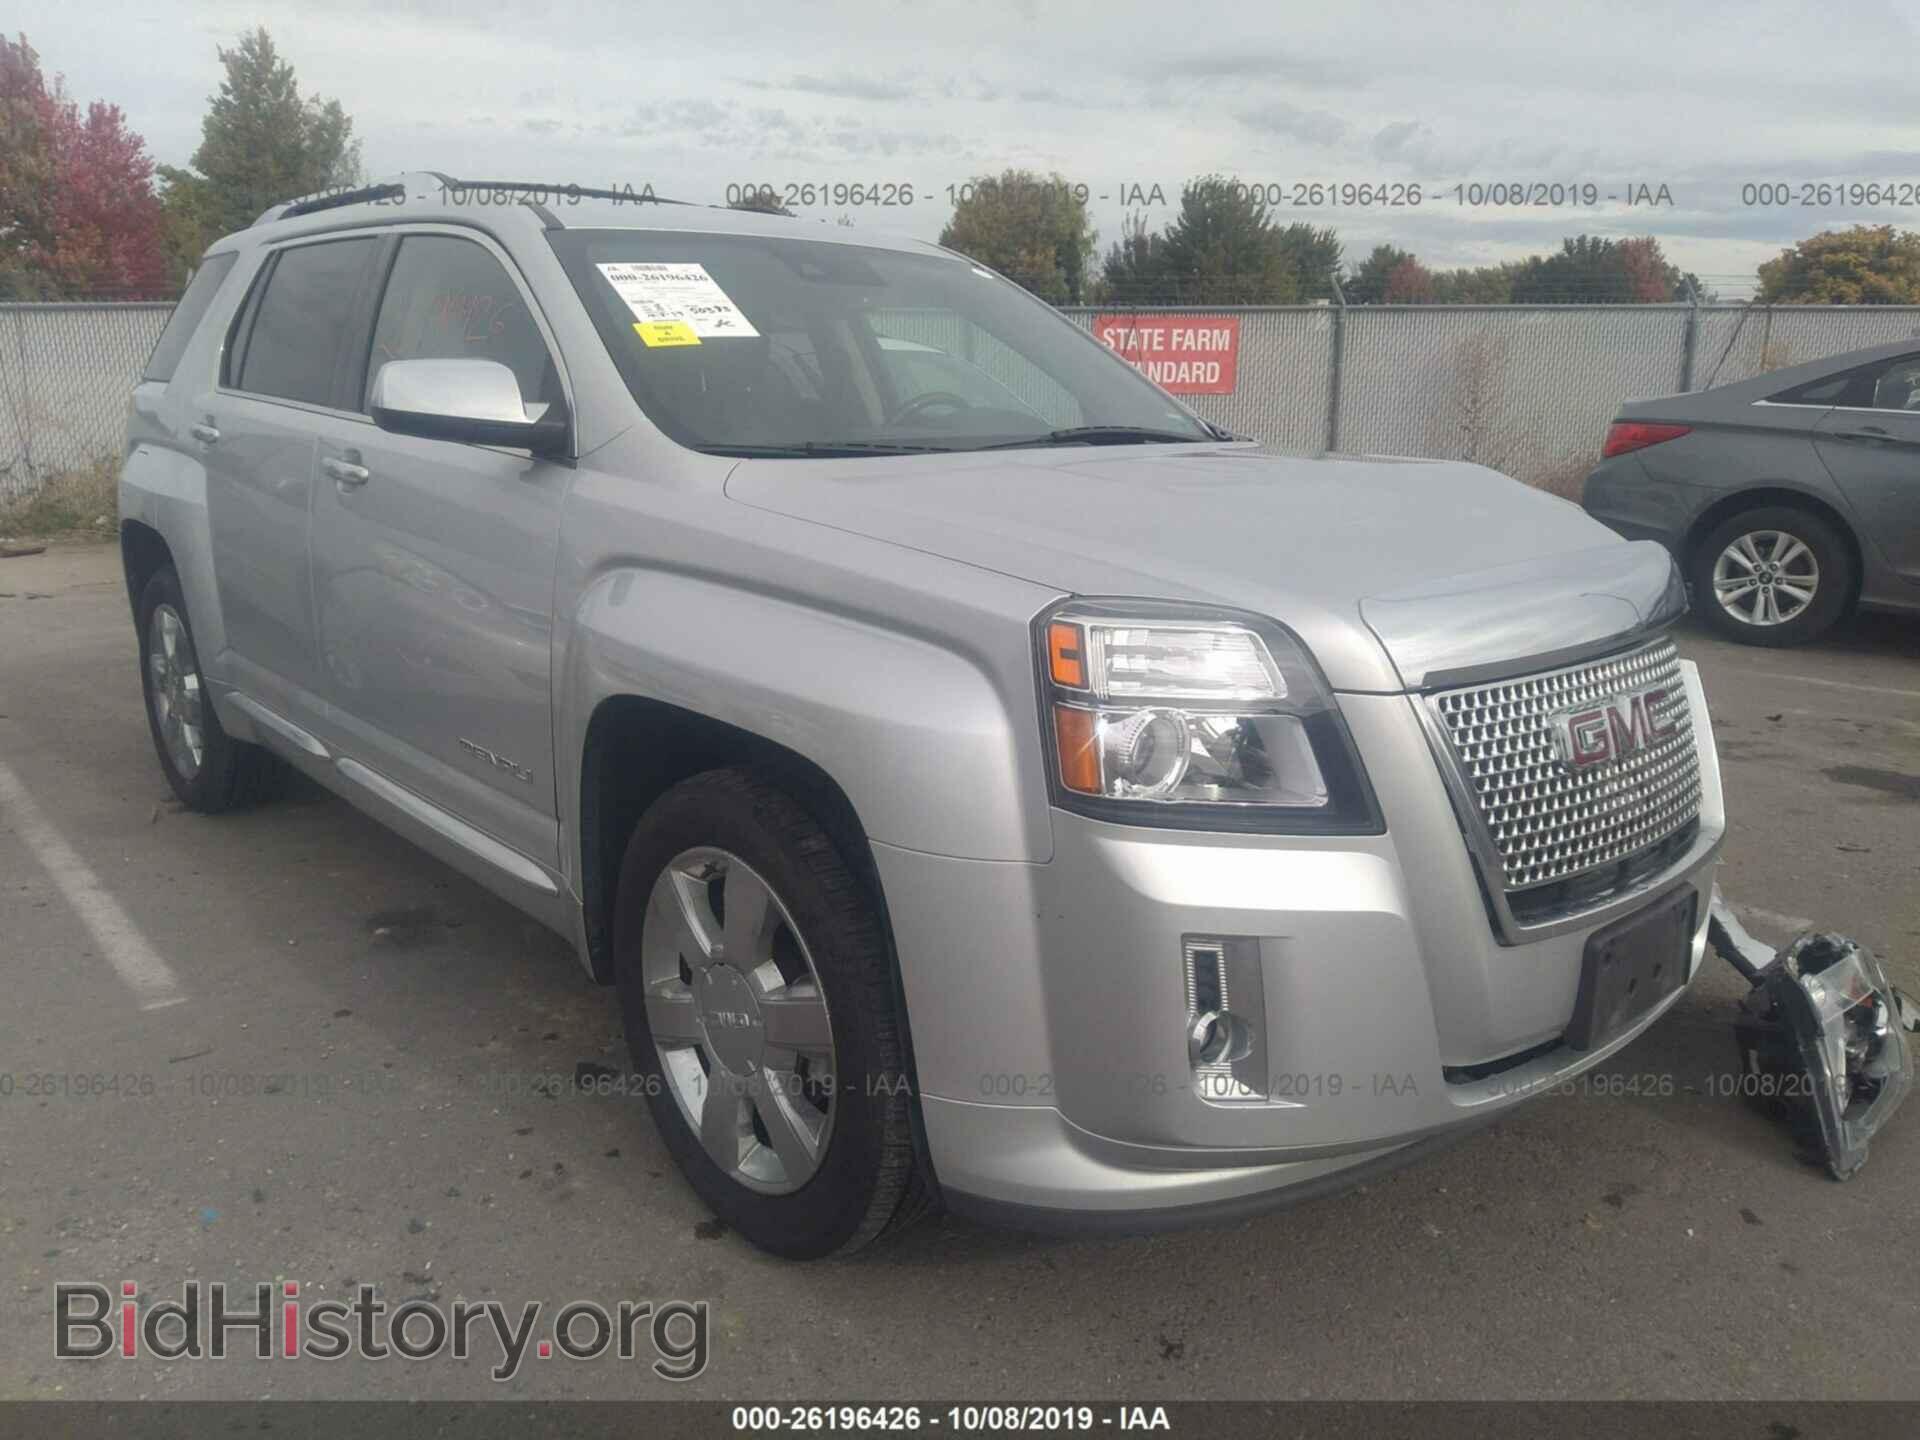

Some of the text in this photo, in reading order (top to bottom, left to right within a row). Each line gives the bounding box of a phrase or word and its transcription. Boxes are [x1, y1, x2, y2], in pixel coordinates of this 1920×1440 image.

[1103, 328, 1231, 351] STATE FARM
[1568, 689, 1679, 767] GMC
